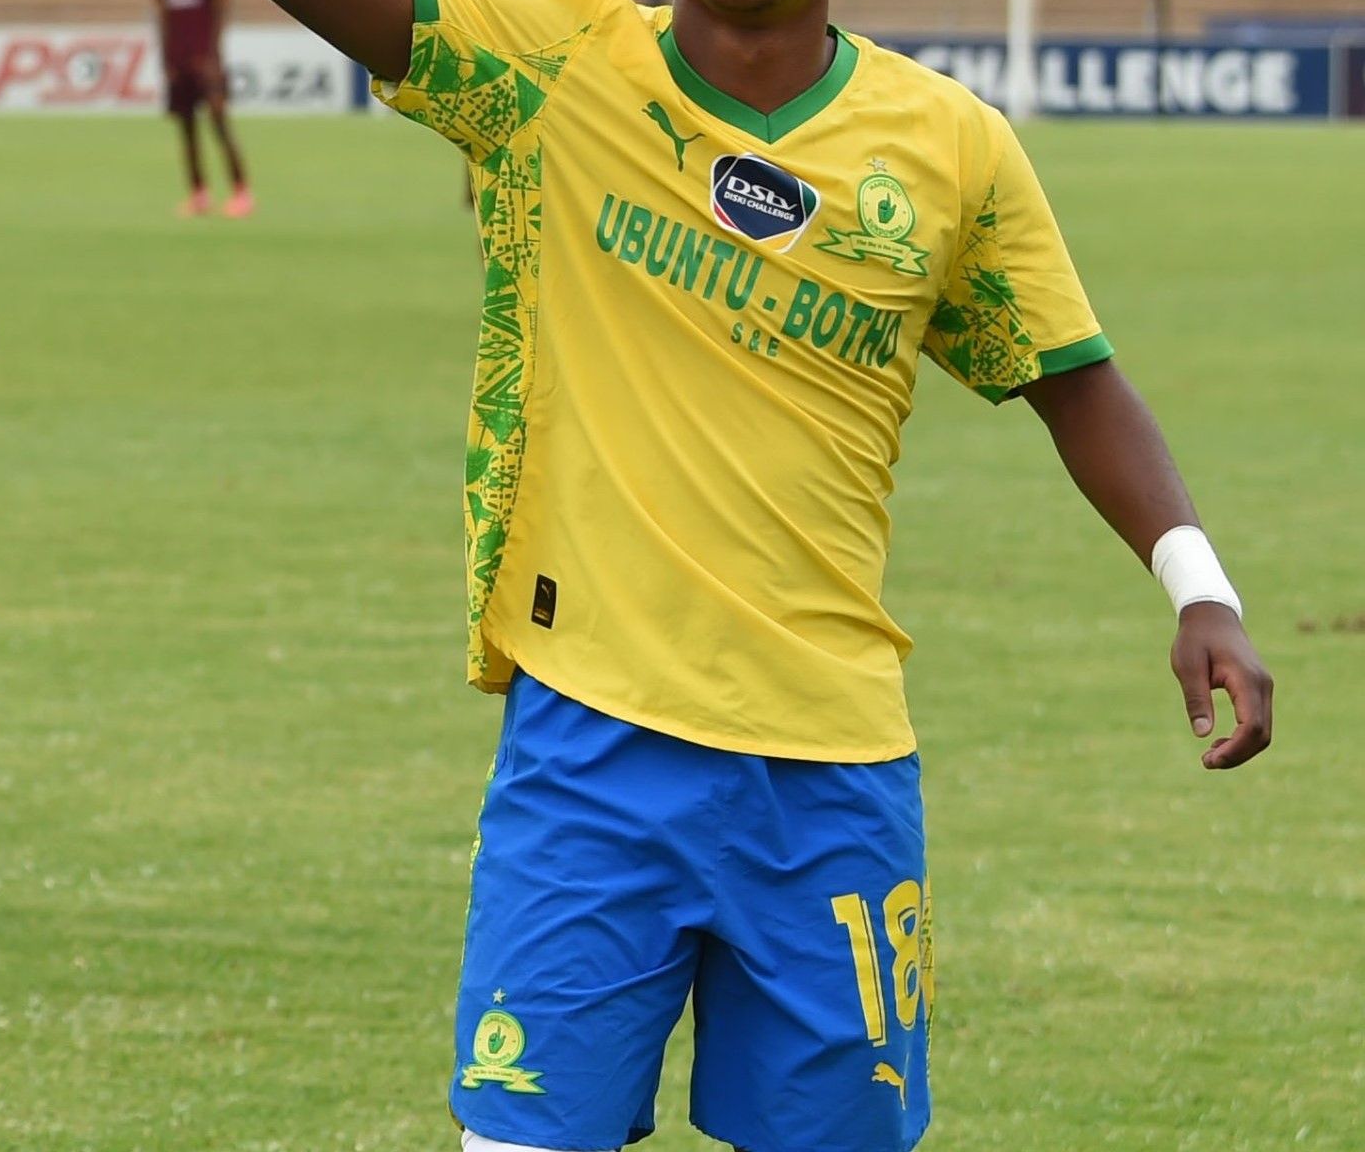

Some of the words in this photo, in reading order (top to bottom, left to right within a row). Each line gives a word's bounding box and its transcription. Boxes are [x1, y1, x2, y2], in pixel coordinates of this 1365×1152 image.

[723, 190, 747, 206] DISKI
[746, 199, 797, 222] CHALLENGE
[726, 175, 798, 210] DStv
[595, 193, 766, 311] UBUNTU
[780, 278, 903, 369] BOTHO
[730, 322, 743, 345] S
[747, 328, 761, 352] &
[766, 335, 782, 358] E
[830, 879, 922, 1048] 18
